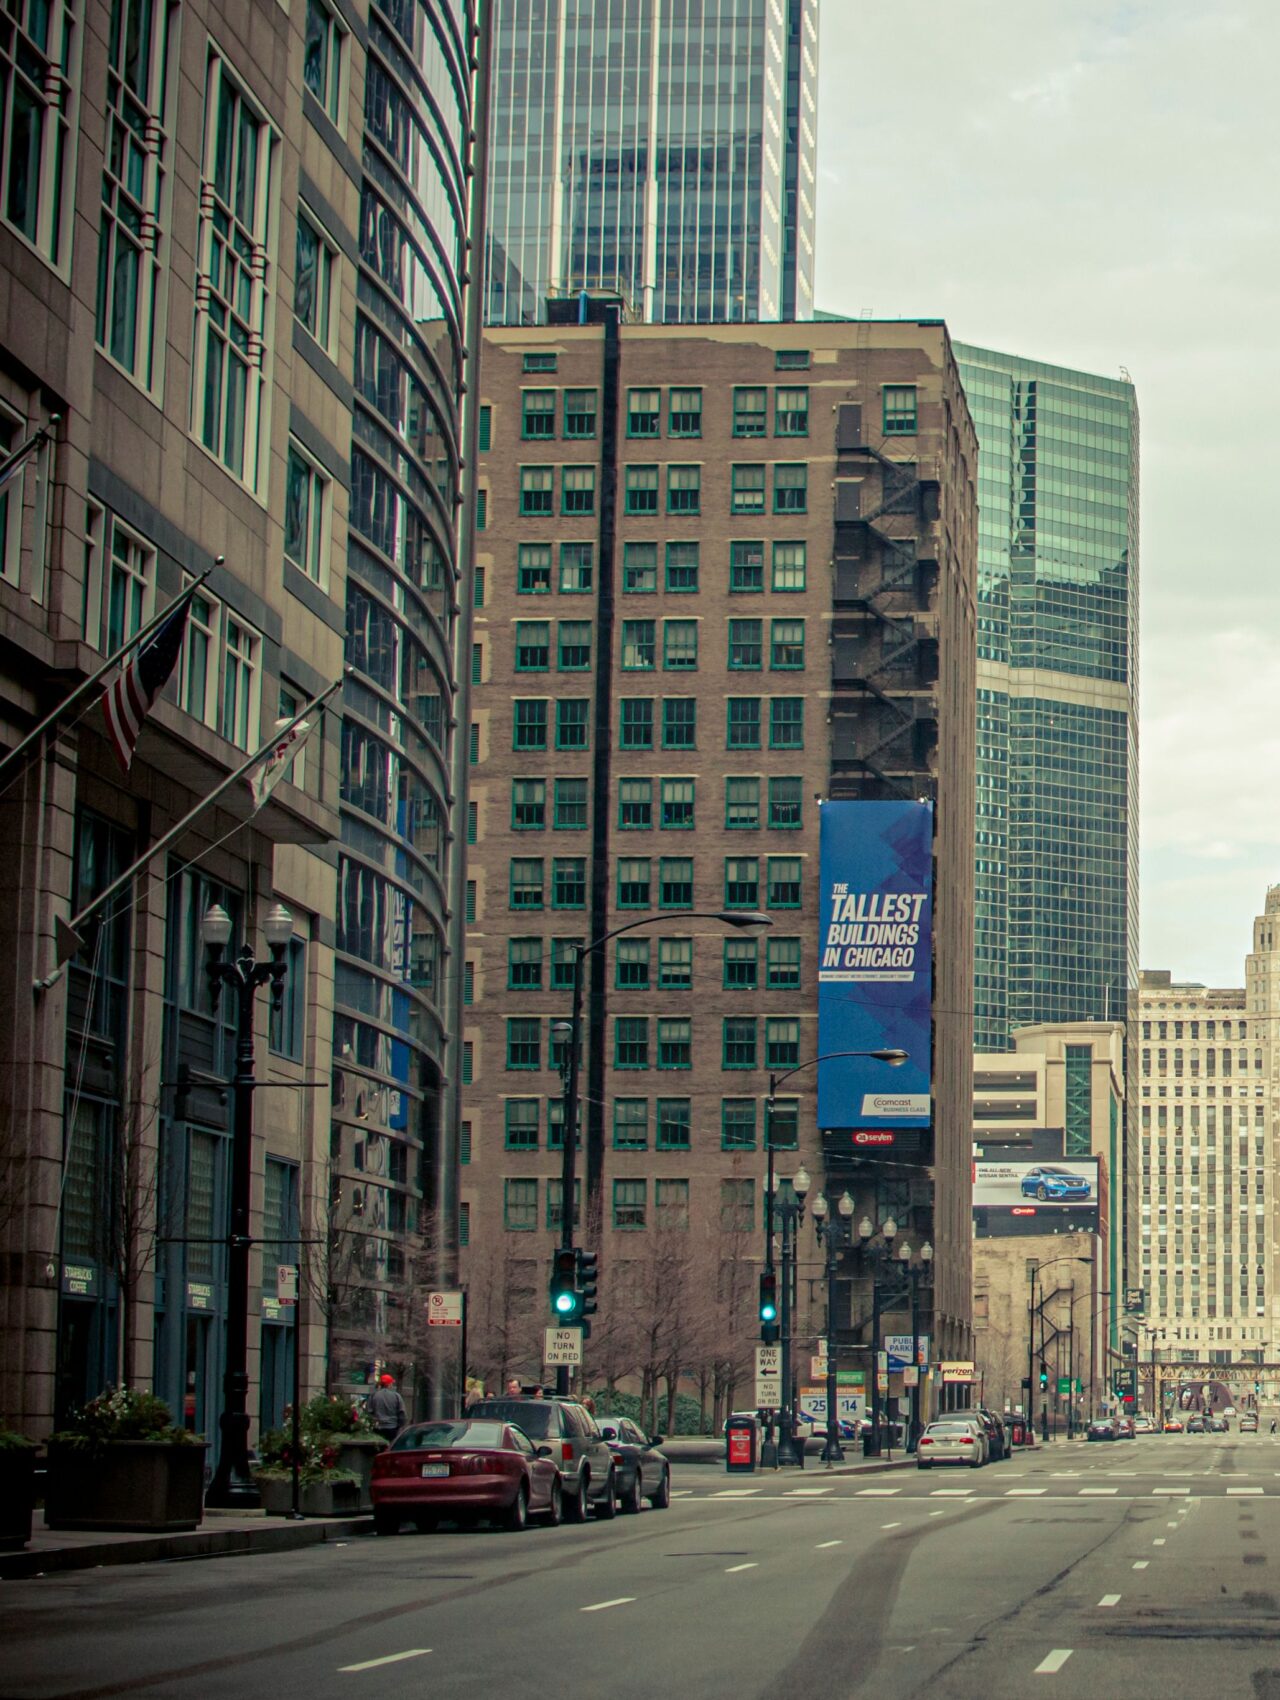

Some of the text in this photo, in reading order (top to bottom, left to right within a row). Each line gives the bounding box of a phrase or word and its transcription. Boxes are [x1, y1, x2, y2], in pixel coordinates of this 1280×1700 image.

[833, 883, 849, 894] THE
[831, 894, 928, 922] TALLEST
[827, 924, 920, 946] BUILDINGS
[822, 947, 915, 967] IN CHICAGO
[874, 1097, 911, 1108] comcast
[65, 1265, 93, 1280] STARBUCKS
[556, 1332, 571, 1340] NO
[552, 1342, 575, 1350] TURN
[547, 1352, 579, 1360] ON RED
[760, 1349, 777, 1358] ONE
[760, 1358, 778, 1366] WAY
[943, 1366, 973, 1375] verizon
[808, 1400, 826, 1412] $25
[841, 1400, 857, 1412] $14
